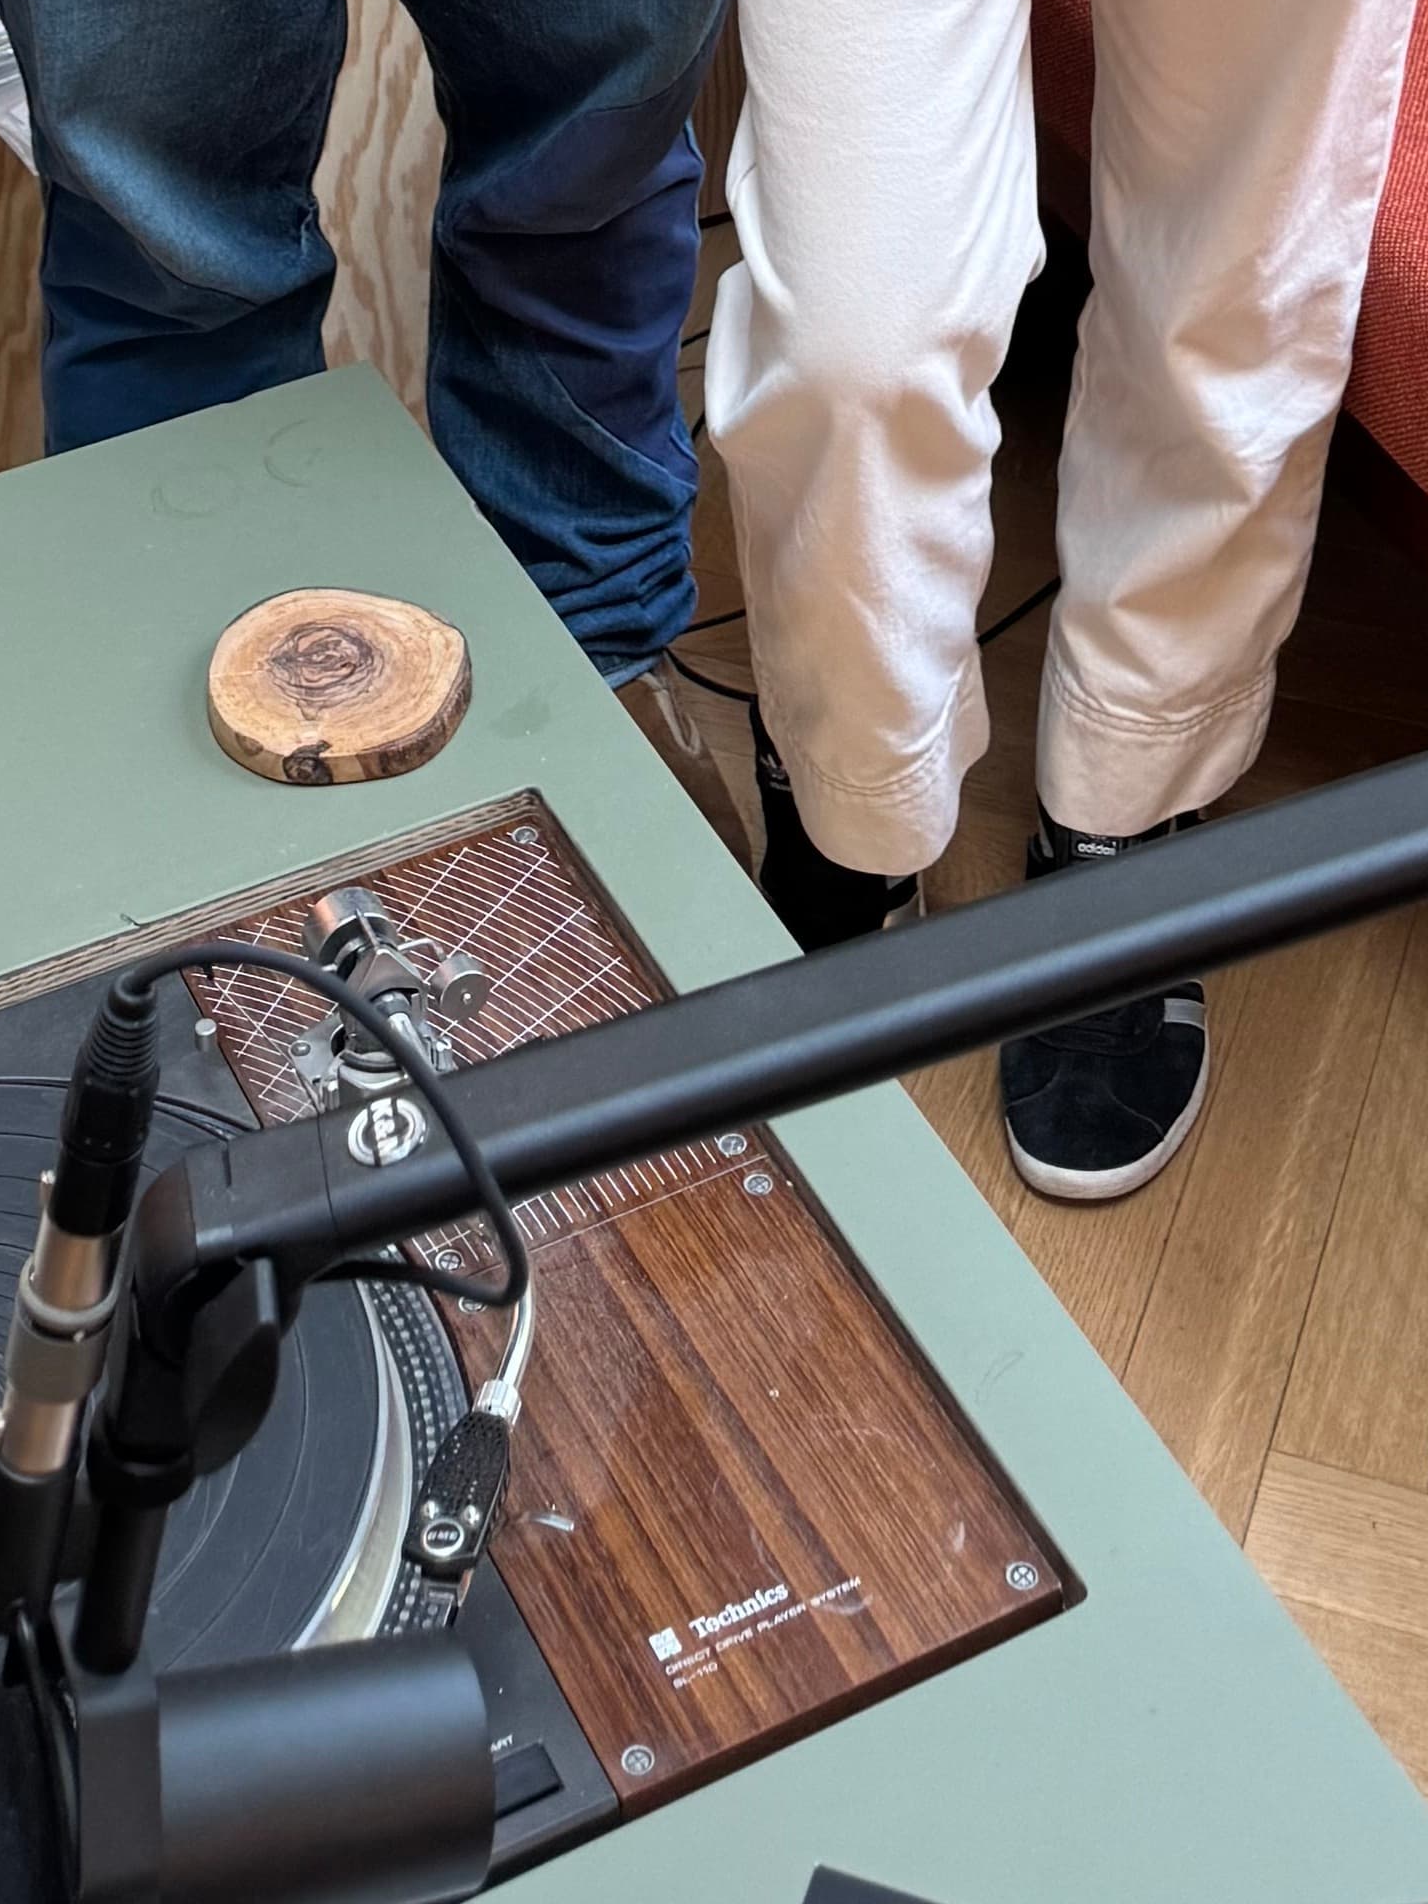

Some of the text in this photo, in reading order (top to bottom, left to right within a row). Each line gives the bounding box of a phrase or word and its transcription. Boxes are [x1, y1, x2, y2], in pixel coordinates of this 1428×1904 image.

[1077, 841, 1116, 856] adidas
[665, 1575, 862, 1676] DIRECT DRIVE PLAYER SYSTEM
[688, 1583, 789, 1639] Technics
[490, 1734, 514, 1752] ART
